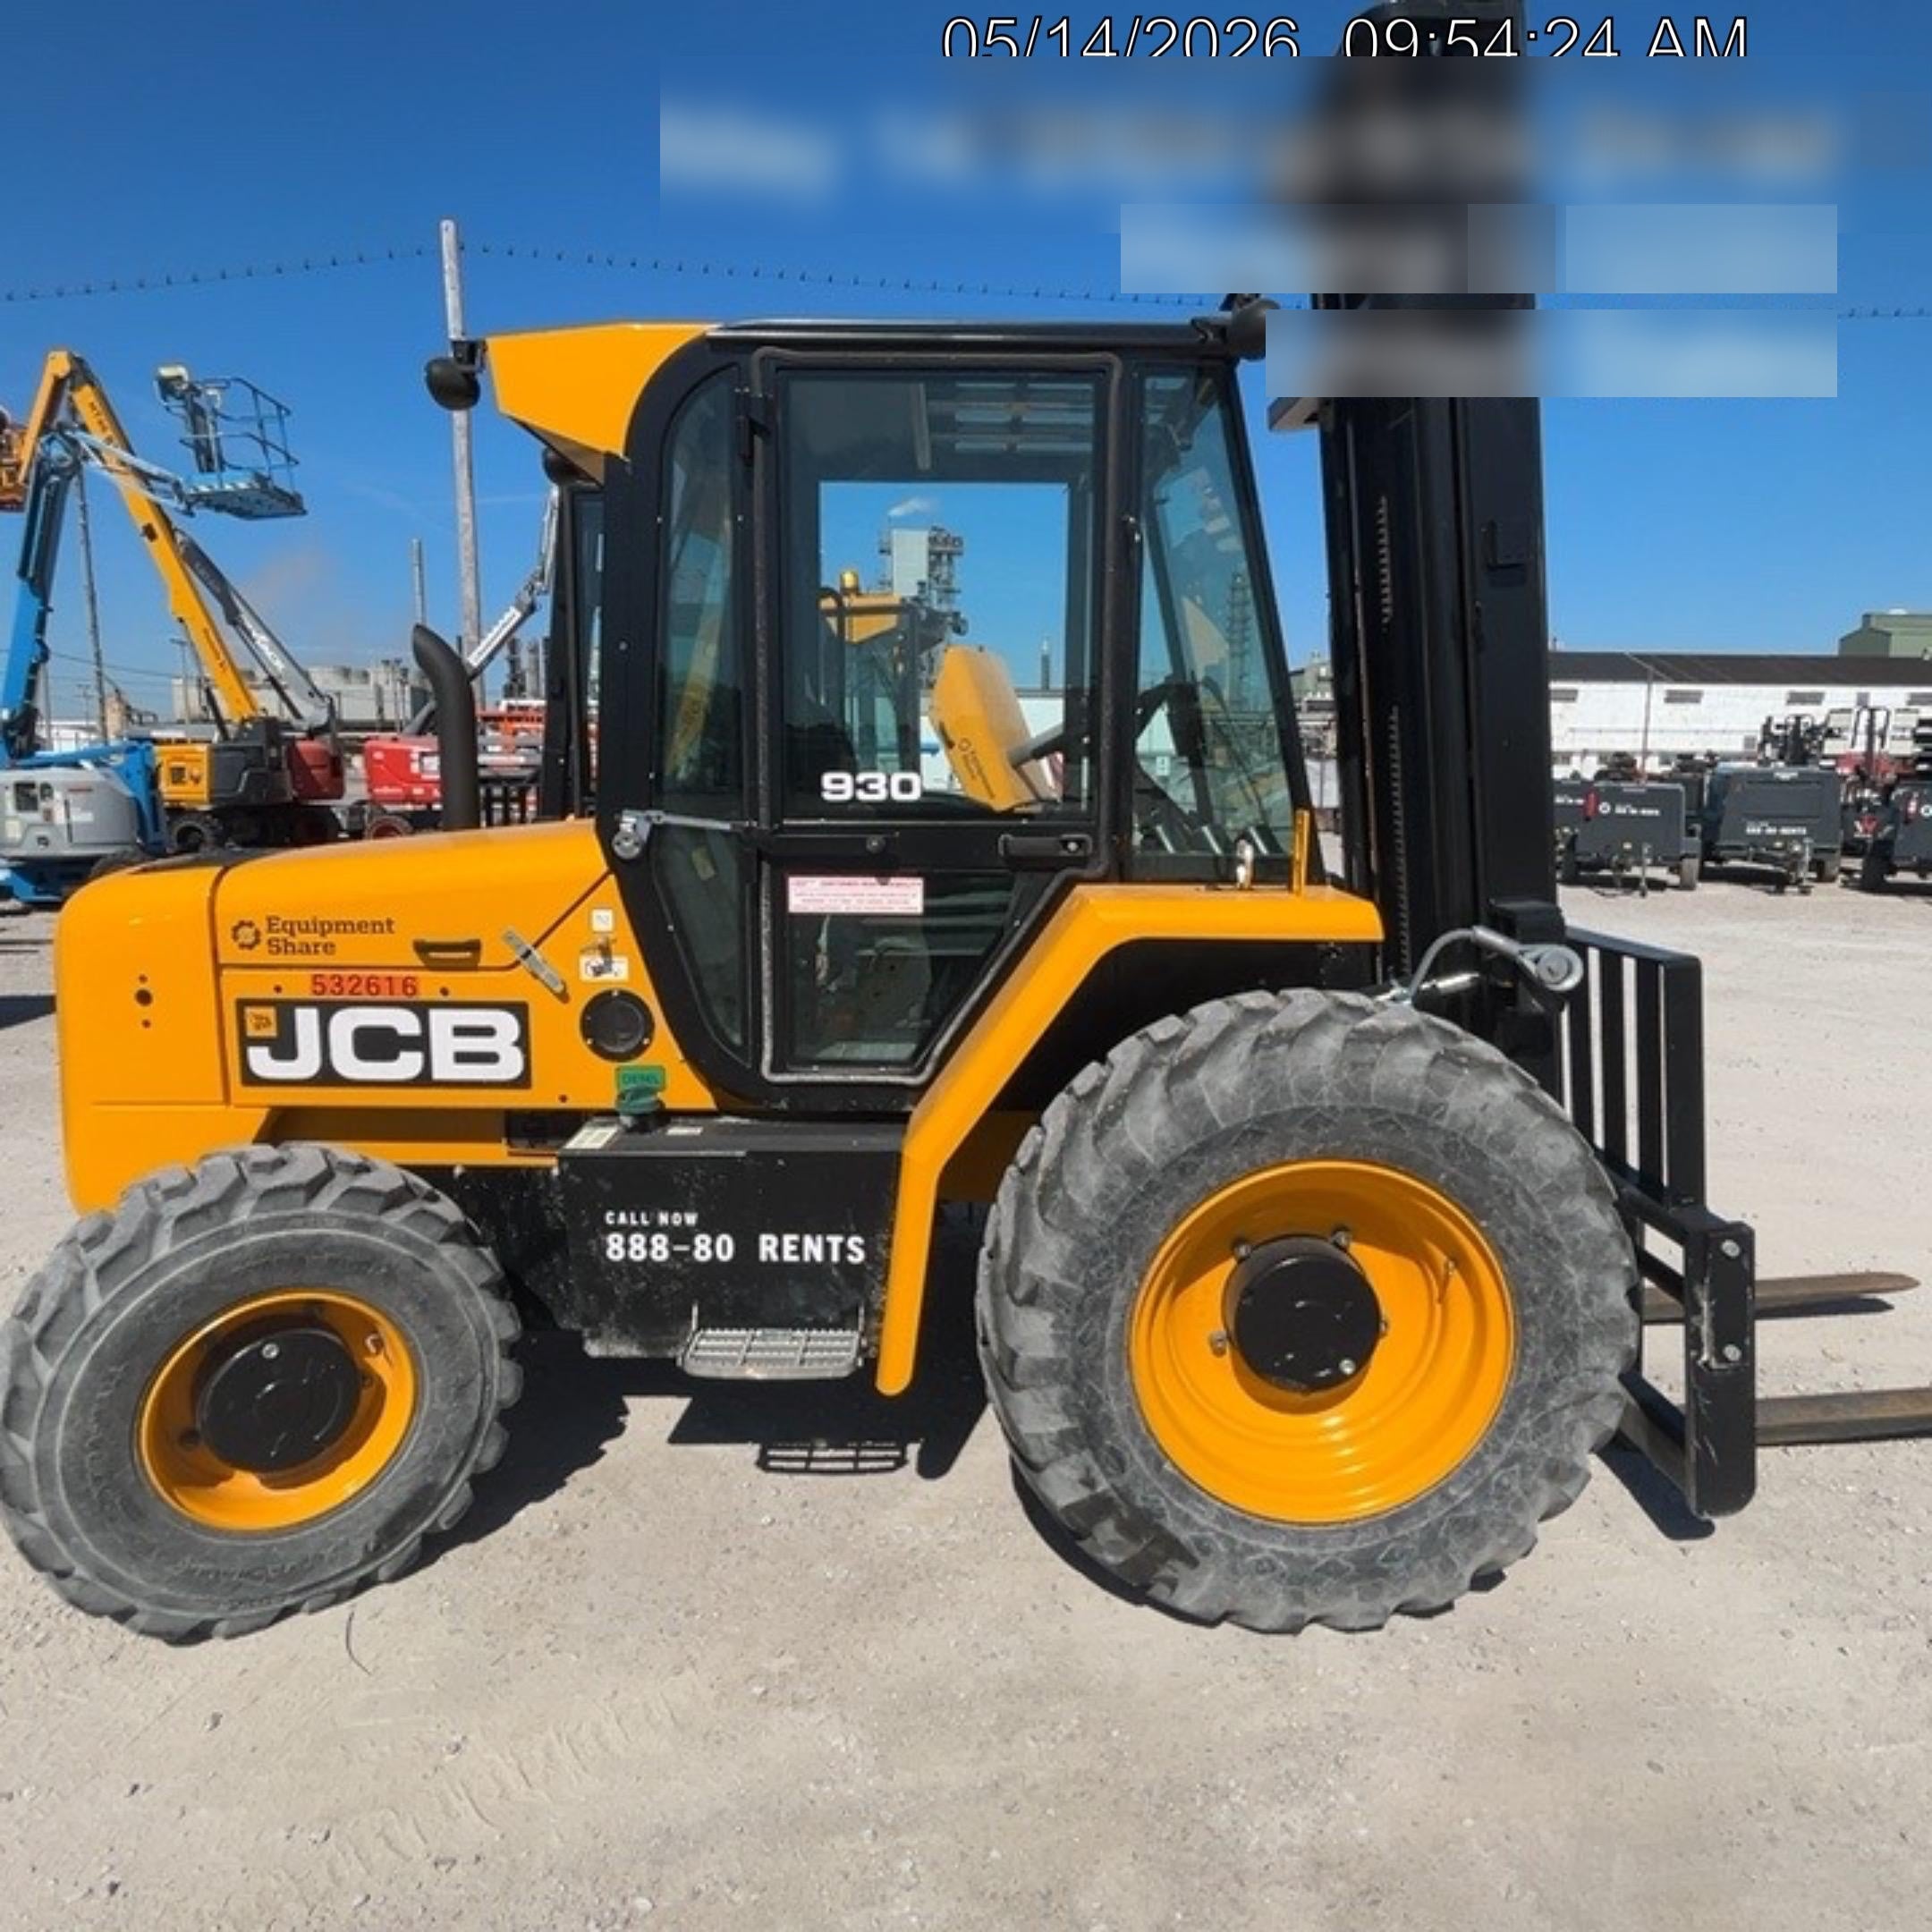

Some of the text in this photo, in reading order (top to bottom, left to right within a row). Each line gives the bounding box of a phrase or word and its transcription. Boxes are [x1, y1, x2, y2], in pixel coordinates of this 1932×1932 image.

[821, 772, 921, 801] 930
[266, 916, 395, 936] Equipment
[267, 936, 336, 955] Share
[311, 974, 418, 996] 532616
[247, 1007, 525, 1080] JCB
[605, 1212, 699, 1226] CALL NOW
[606, 1233, 866, 1264] 888-80 RENTS
